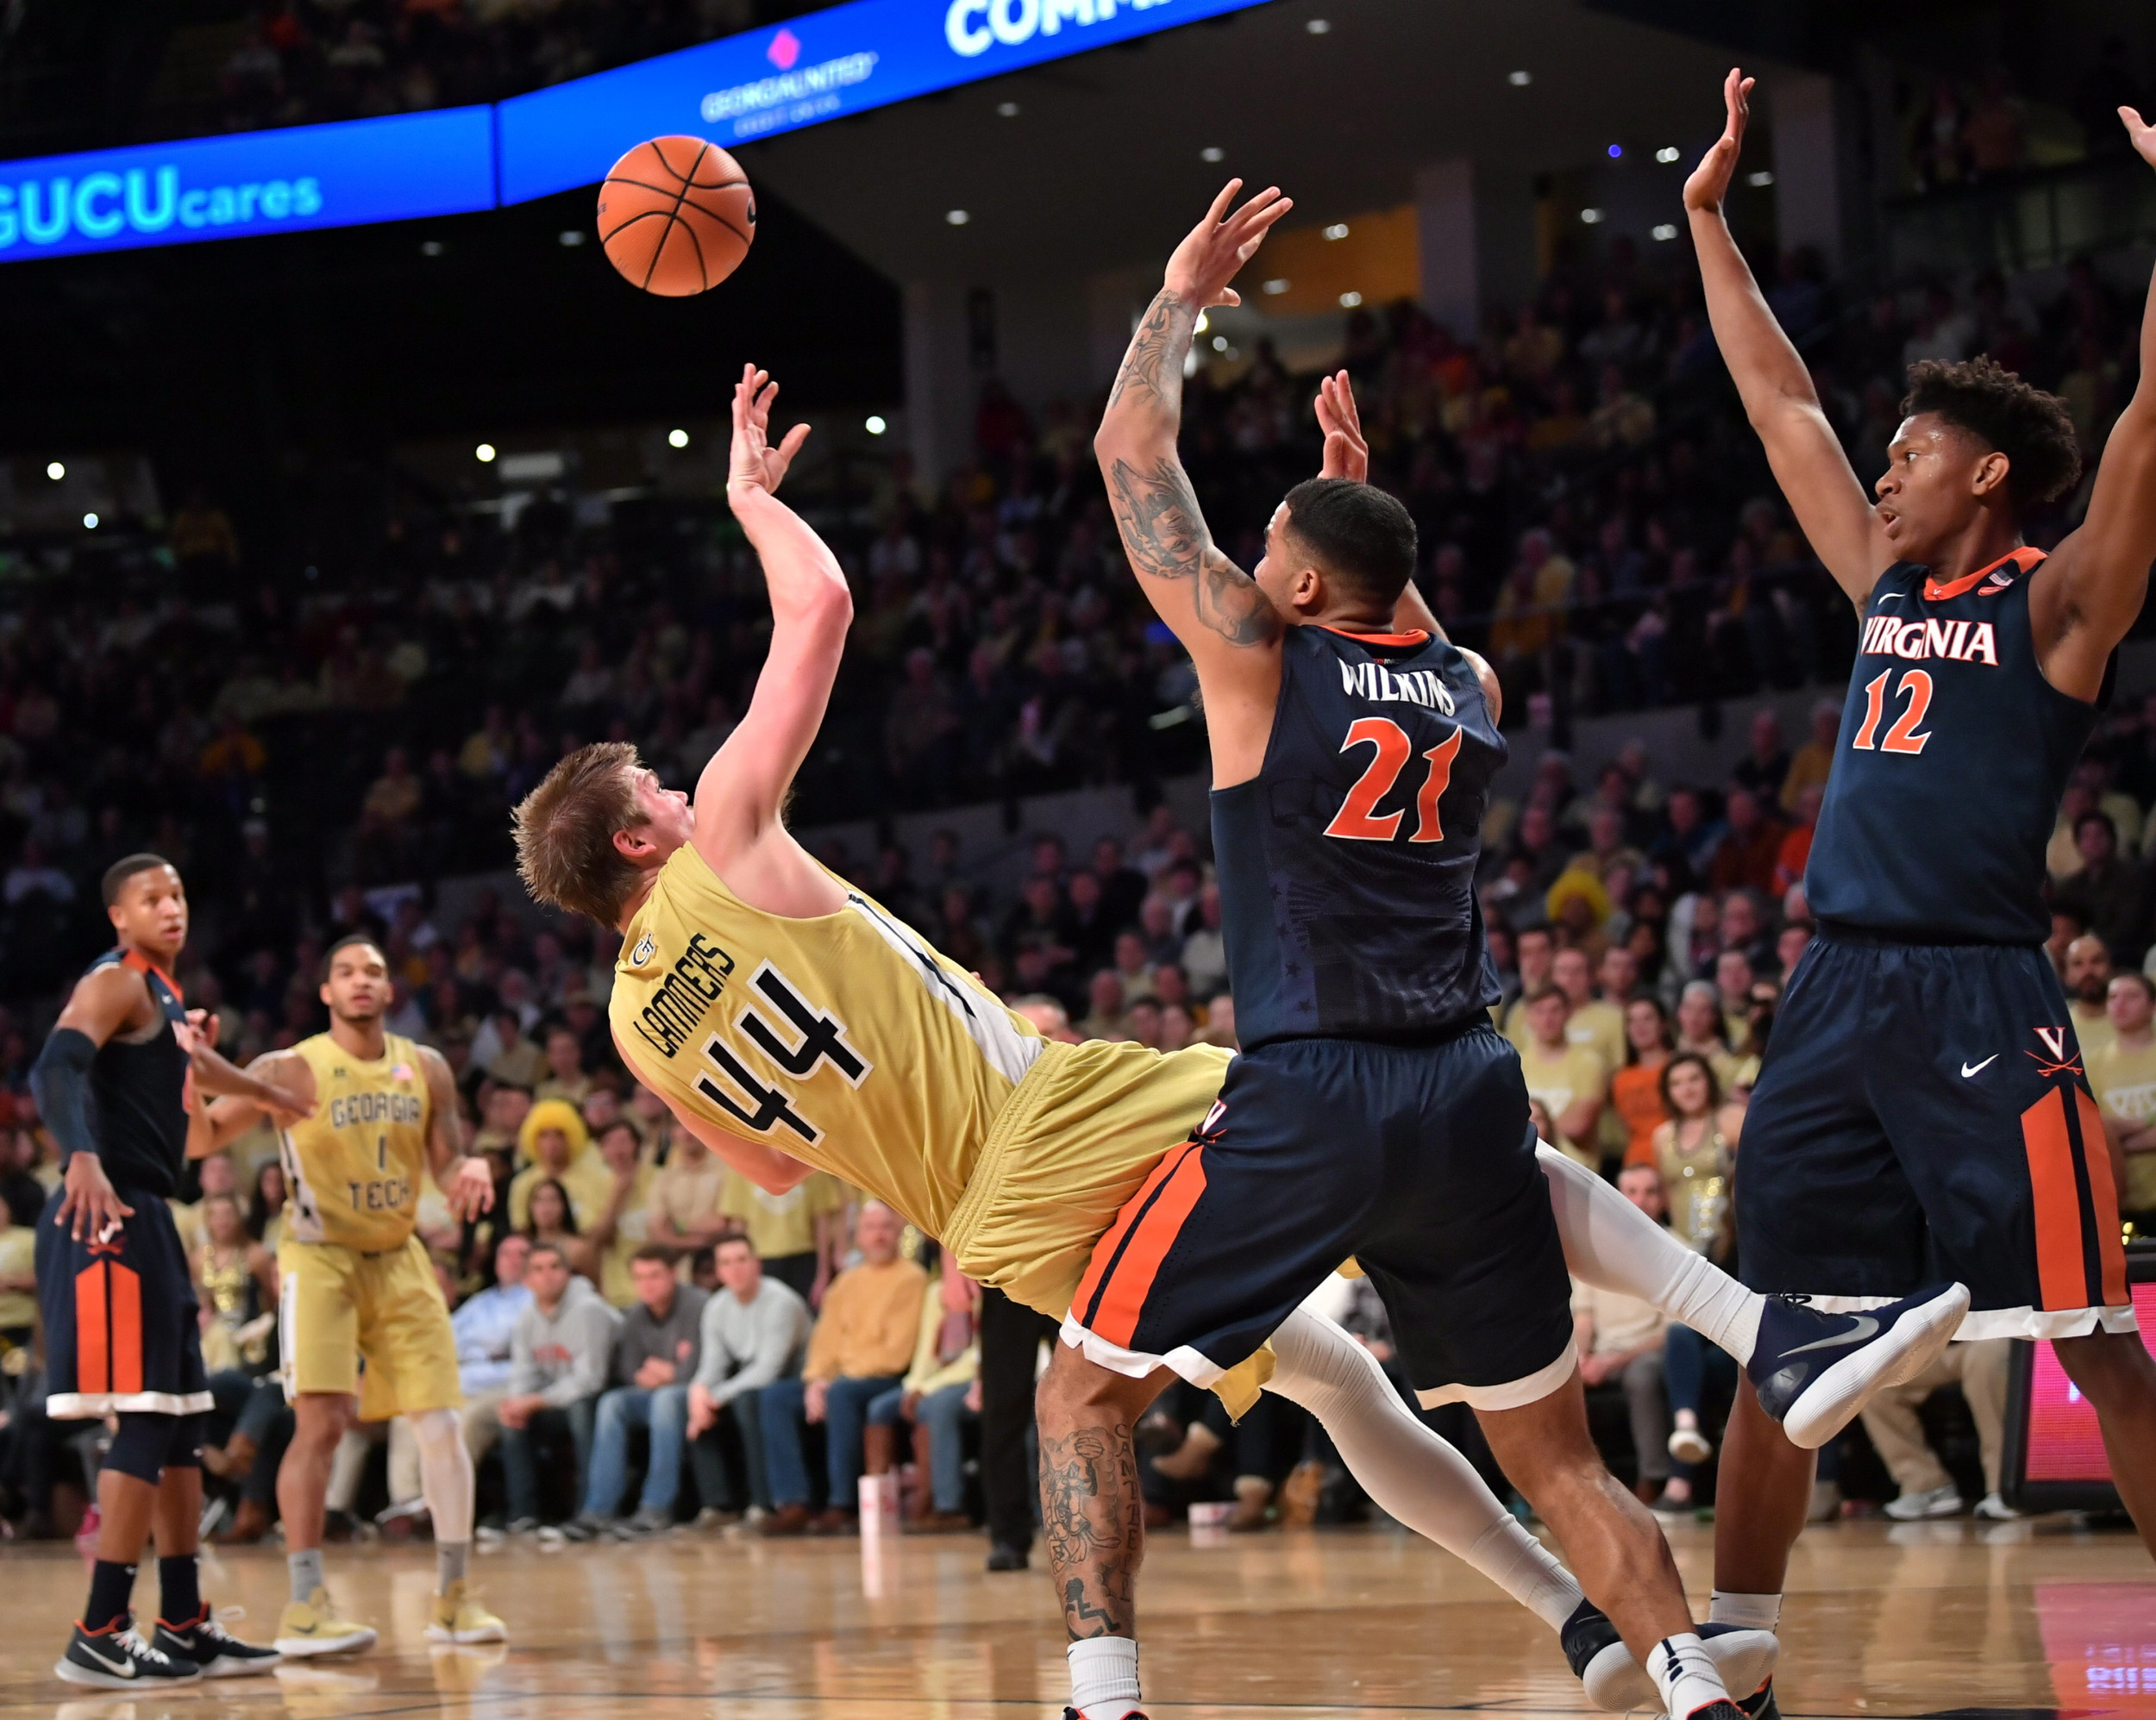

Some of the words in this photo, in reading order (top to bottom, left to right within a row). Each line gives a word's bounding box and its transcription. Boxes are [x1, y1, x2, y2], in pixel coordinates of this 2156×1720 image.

[1337, 656, 1455, 717] WILKINS
[1853, 667, 1934, 755] 12
[1322, 716, 1462, 843] 21
[633, 933, 735, 1059] LAMMERS
[691, 958, 874, 1148] 44
[331, 1091, 422, 1129] GEORGIA
